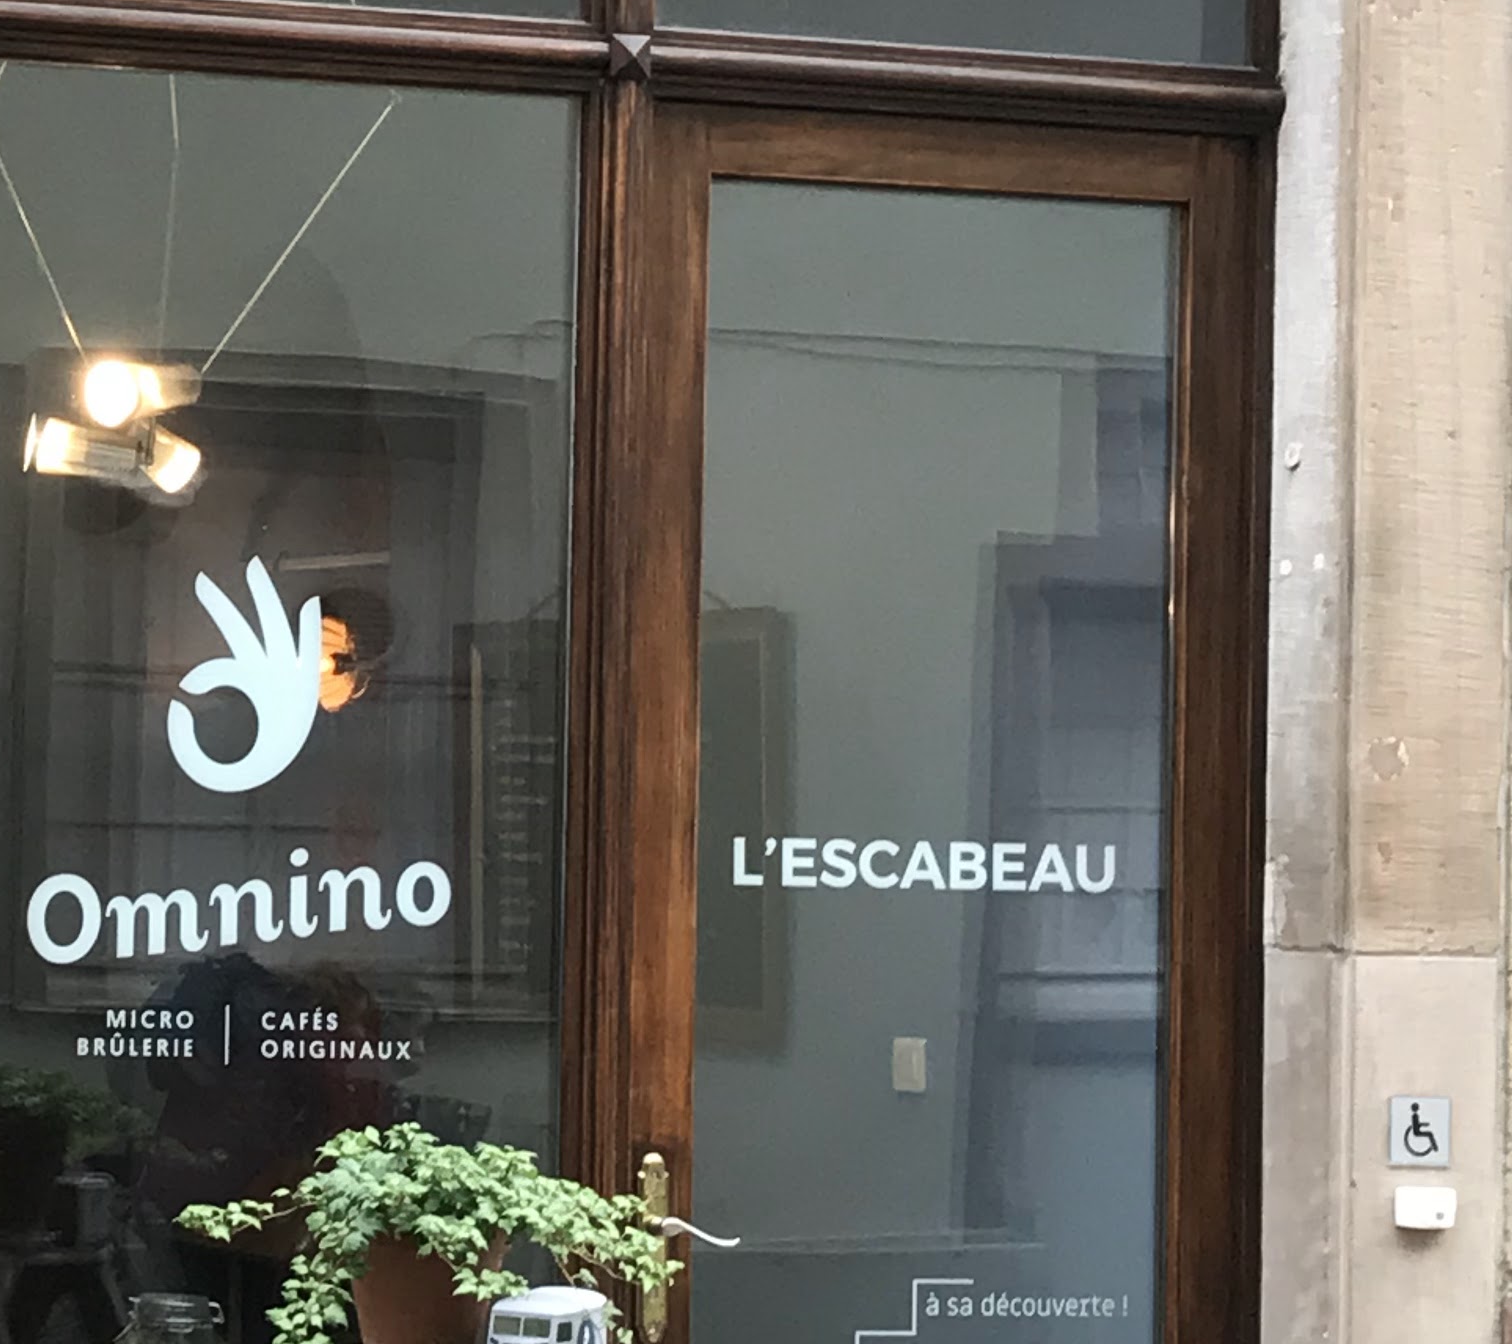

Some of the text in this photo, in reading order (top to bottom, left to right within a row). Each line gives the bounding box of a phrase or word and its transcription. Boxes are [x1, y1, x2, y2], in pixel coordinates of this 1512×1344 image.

[732, 836, 1116, 893] L'ESCABEAU
[27, 847, 452, 964] Omnino
[106, 1010, 194, 1030] MICRO
[261, 1007, 339, 1032] CAFÉS
[77, 1032, 194, 1058] BRÛLERIE
[260, 1039, 411, 1060] ORIGINAUX
[925, 1292, 940, 1316] à
[947, 1297, 973, 1316] sa
[981, 1292, 1115, 1318] découverte
